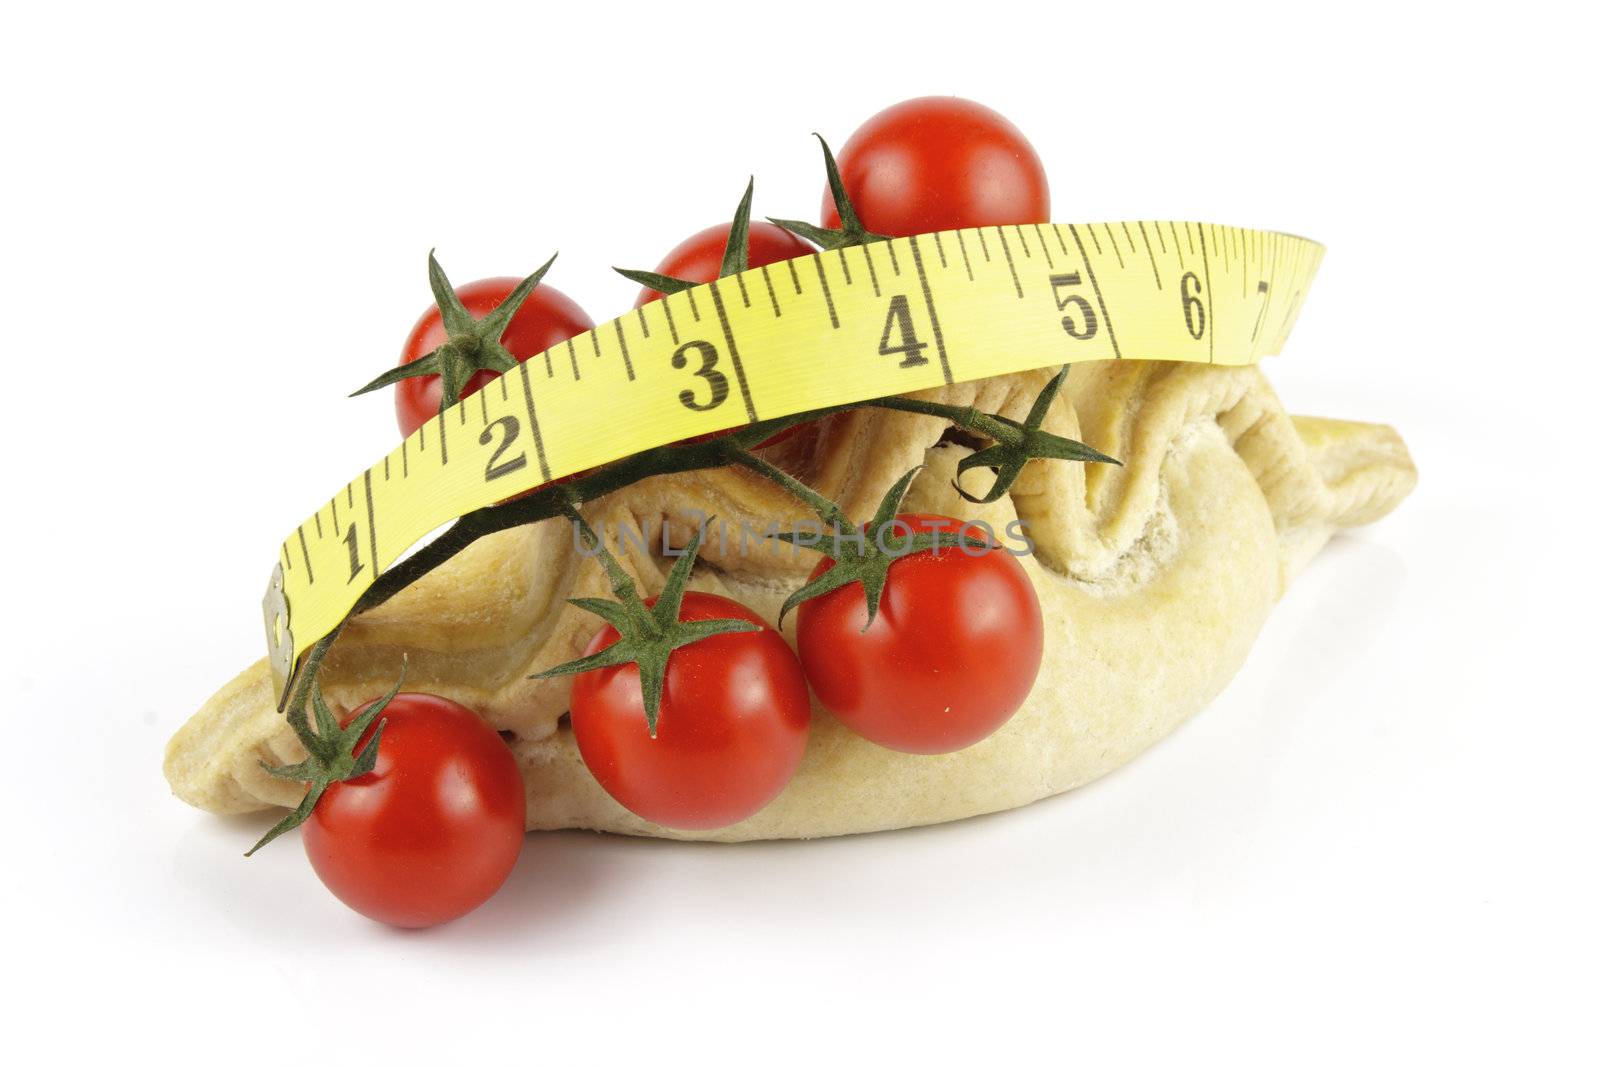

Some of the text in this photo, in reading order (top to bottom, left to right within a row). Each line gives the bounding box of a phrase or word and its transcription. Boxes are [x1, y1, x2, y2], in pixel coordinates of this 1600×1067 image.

[342, 521, 365, 585] 1
[478, 415, 527, 482] 2
[671, 340, 729, 412] 3
[878, 294, 928, 369] 4
[1049, 269, 1098, 340] 5
[1180, 271, 1206, 340] 6
